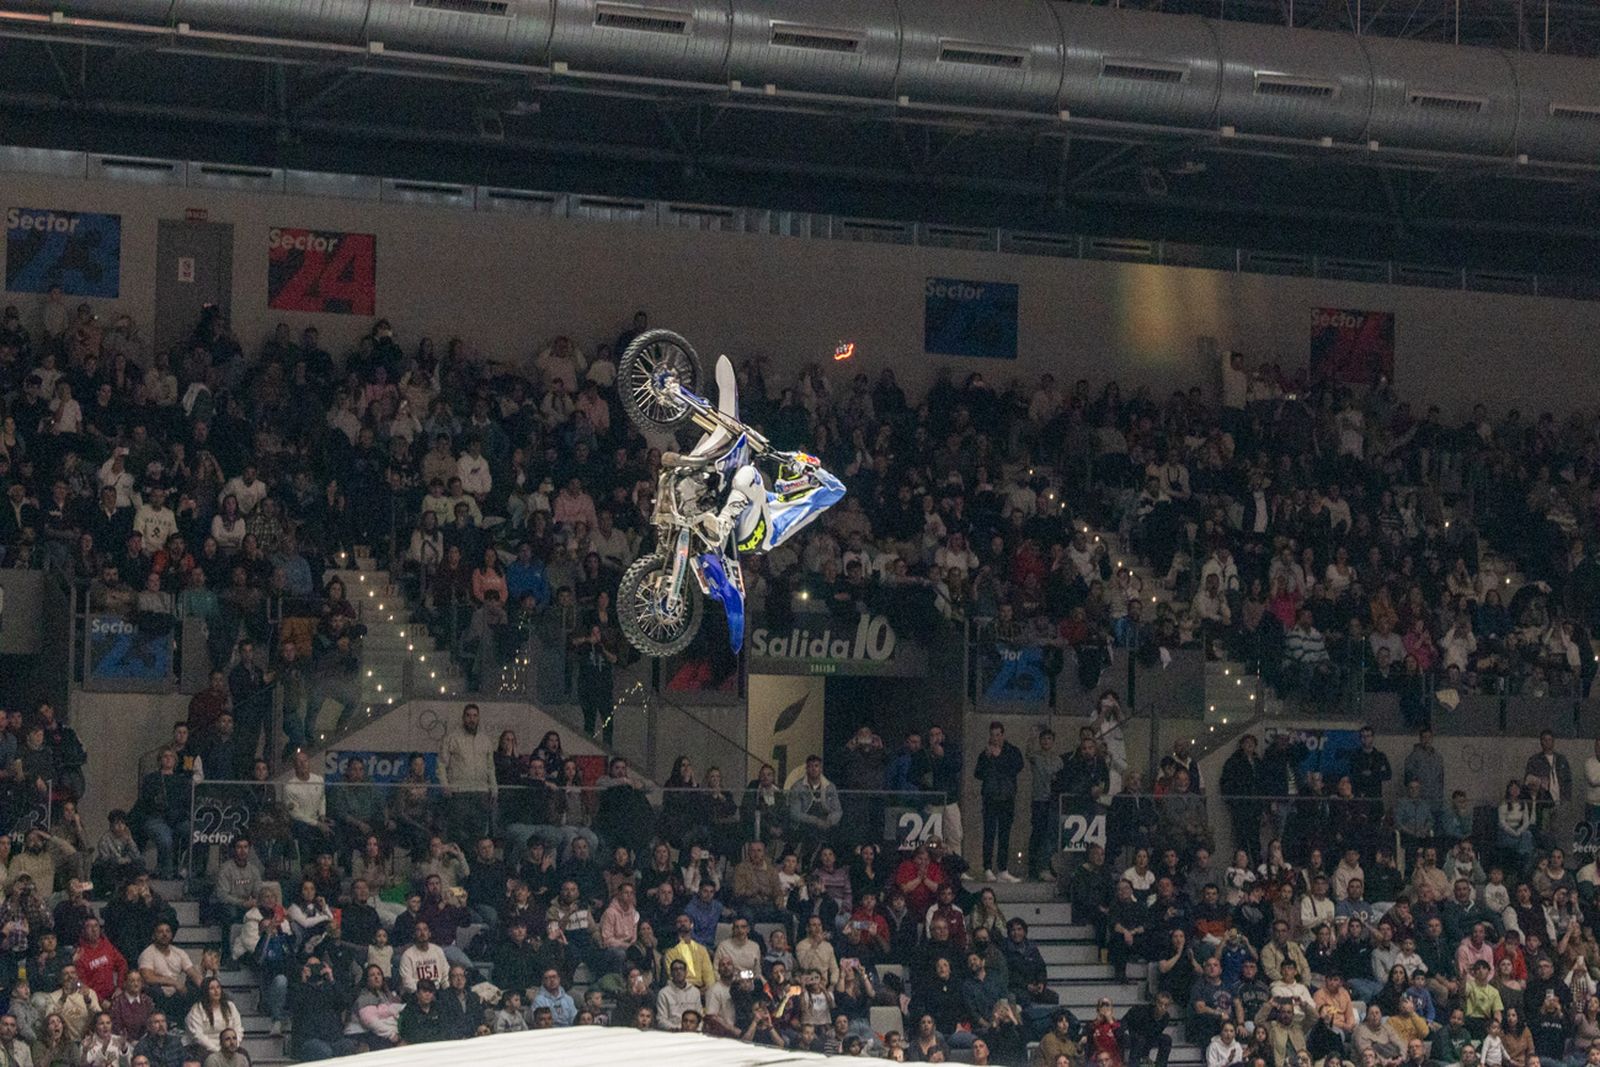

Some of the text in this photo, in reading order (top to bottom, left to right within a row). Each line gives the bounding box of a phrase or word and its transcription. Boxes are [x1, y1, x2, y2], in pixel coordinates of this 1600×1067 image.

[7, 208, 80, 233] Sector
[269, 228, 338, 253] Sector
[925, 279, 985, 300] Sector
[1311, 308, 1365, 329] Sector
[751, 613, 896, 660] Salida 10
[325, 752, 405, 776] Setor
[193, 830, 234, 843] Sector
[898, 812, 944, 851] 24
[1063, 815, 1107, 852] 24
[1573, 842, 1600, 853] Secto
[416, 964, 439, 980] USA
